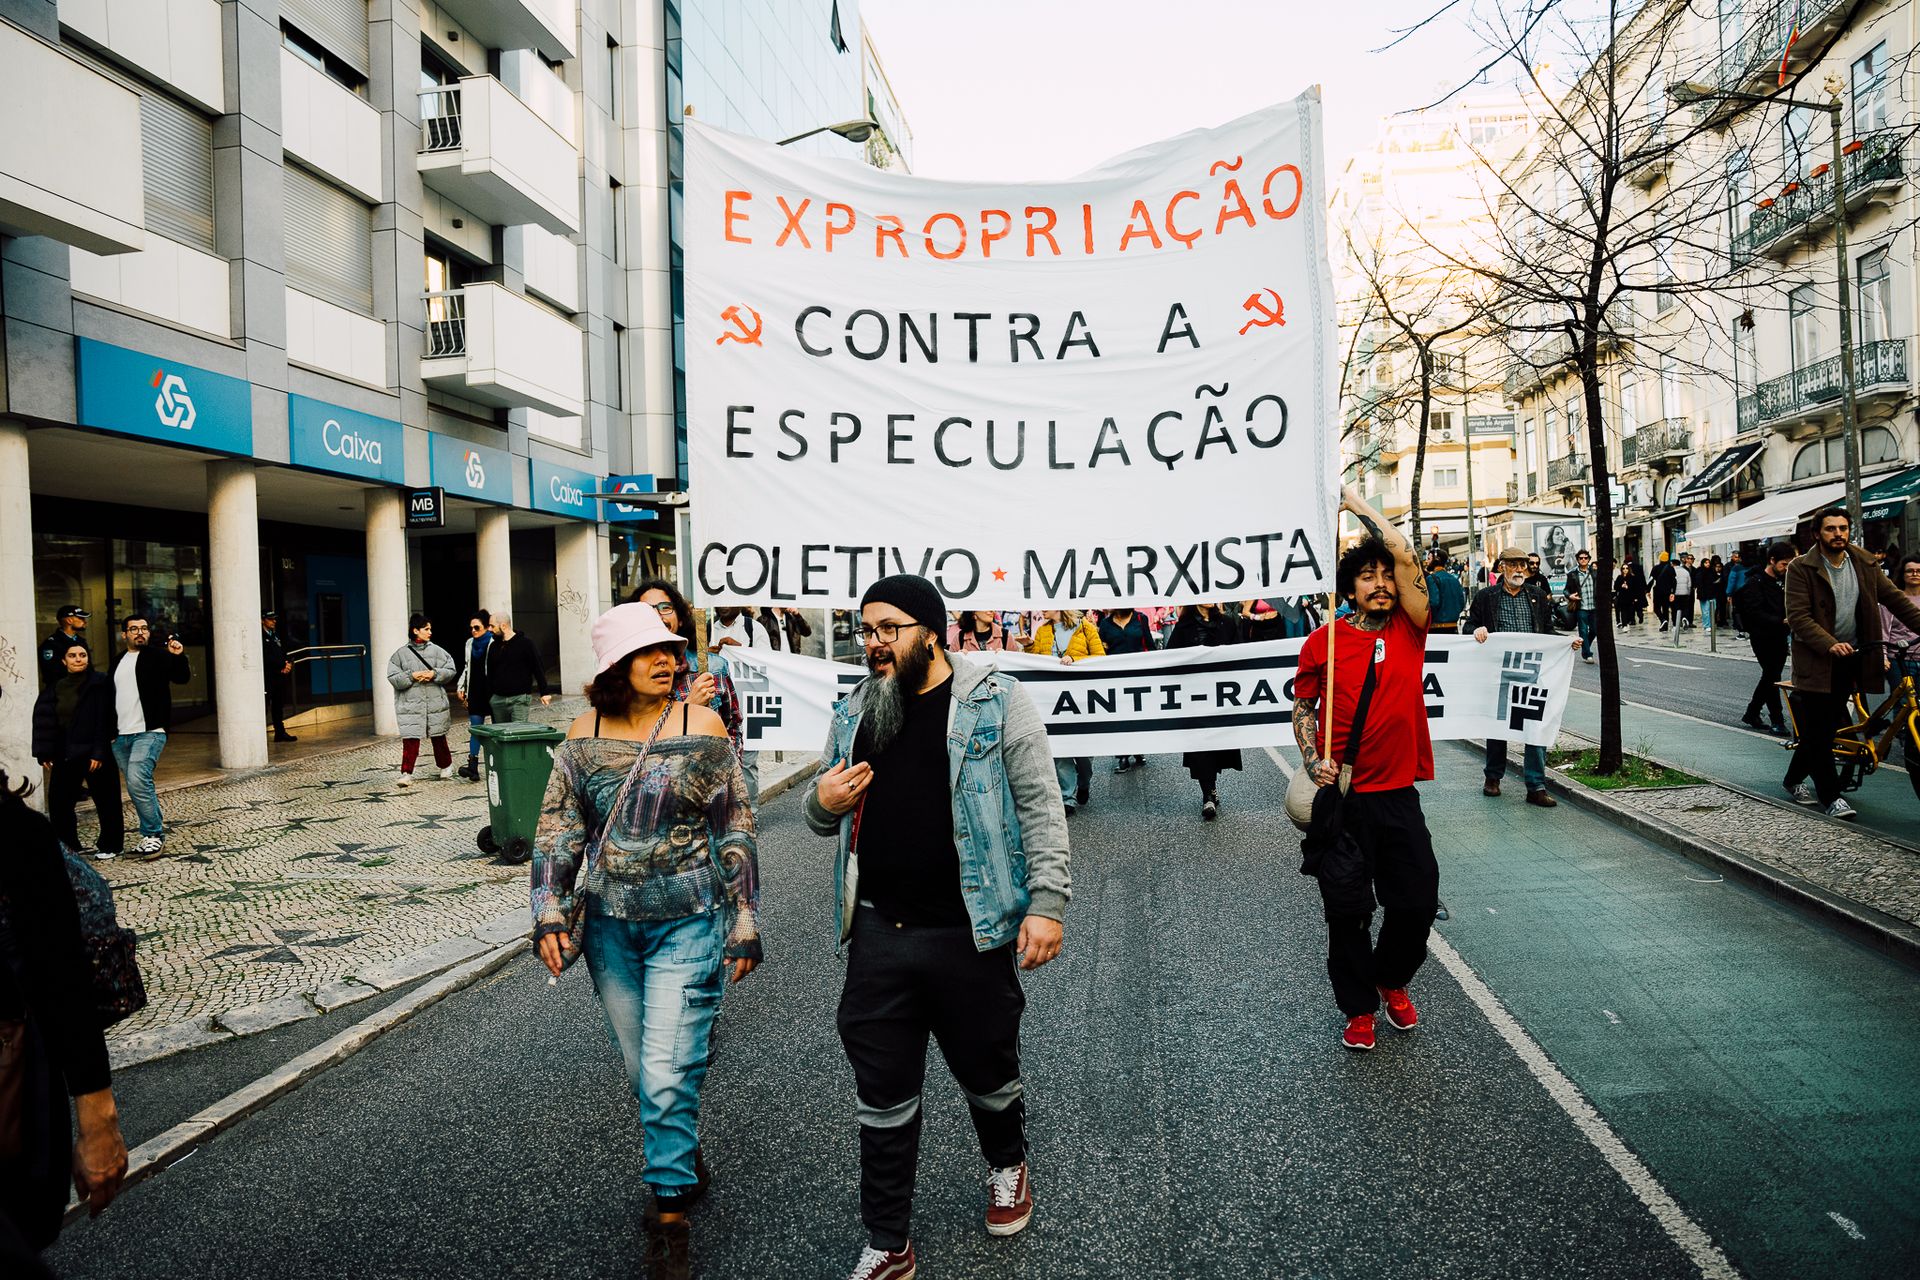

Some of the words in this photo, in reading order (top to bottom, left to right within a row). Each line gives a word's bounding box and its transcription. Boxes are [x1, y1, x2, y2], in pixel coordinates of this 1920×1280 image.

[724, 155, 1303, 260] EXPROPRIAÇÃO
[795, 305, 1101, 364] CONTRA
[1157, 302, 1201, 354] A
[322, 419, 382, 465] Caixa
[726, 382, 1288, 471] ESPECULAÇÃO
[411, 497, 434, 511] MB
[550, 475, 583, 506] Caixa
[698, 542, 980, 601] COLETIVO
[1023, 528, 1323, 600] MARXISTA
